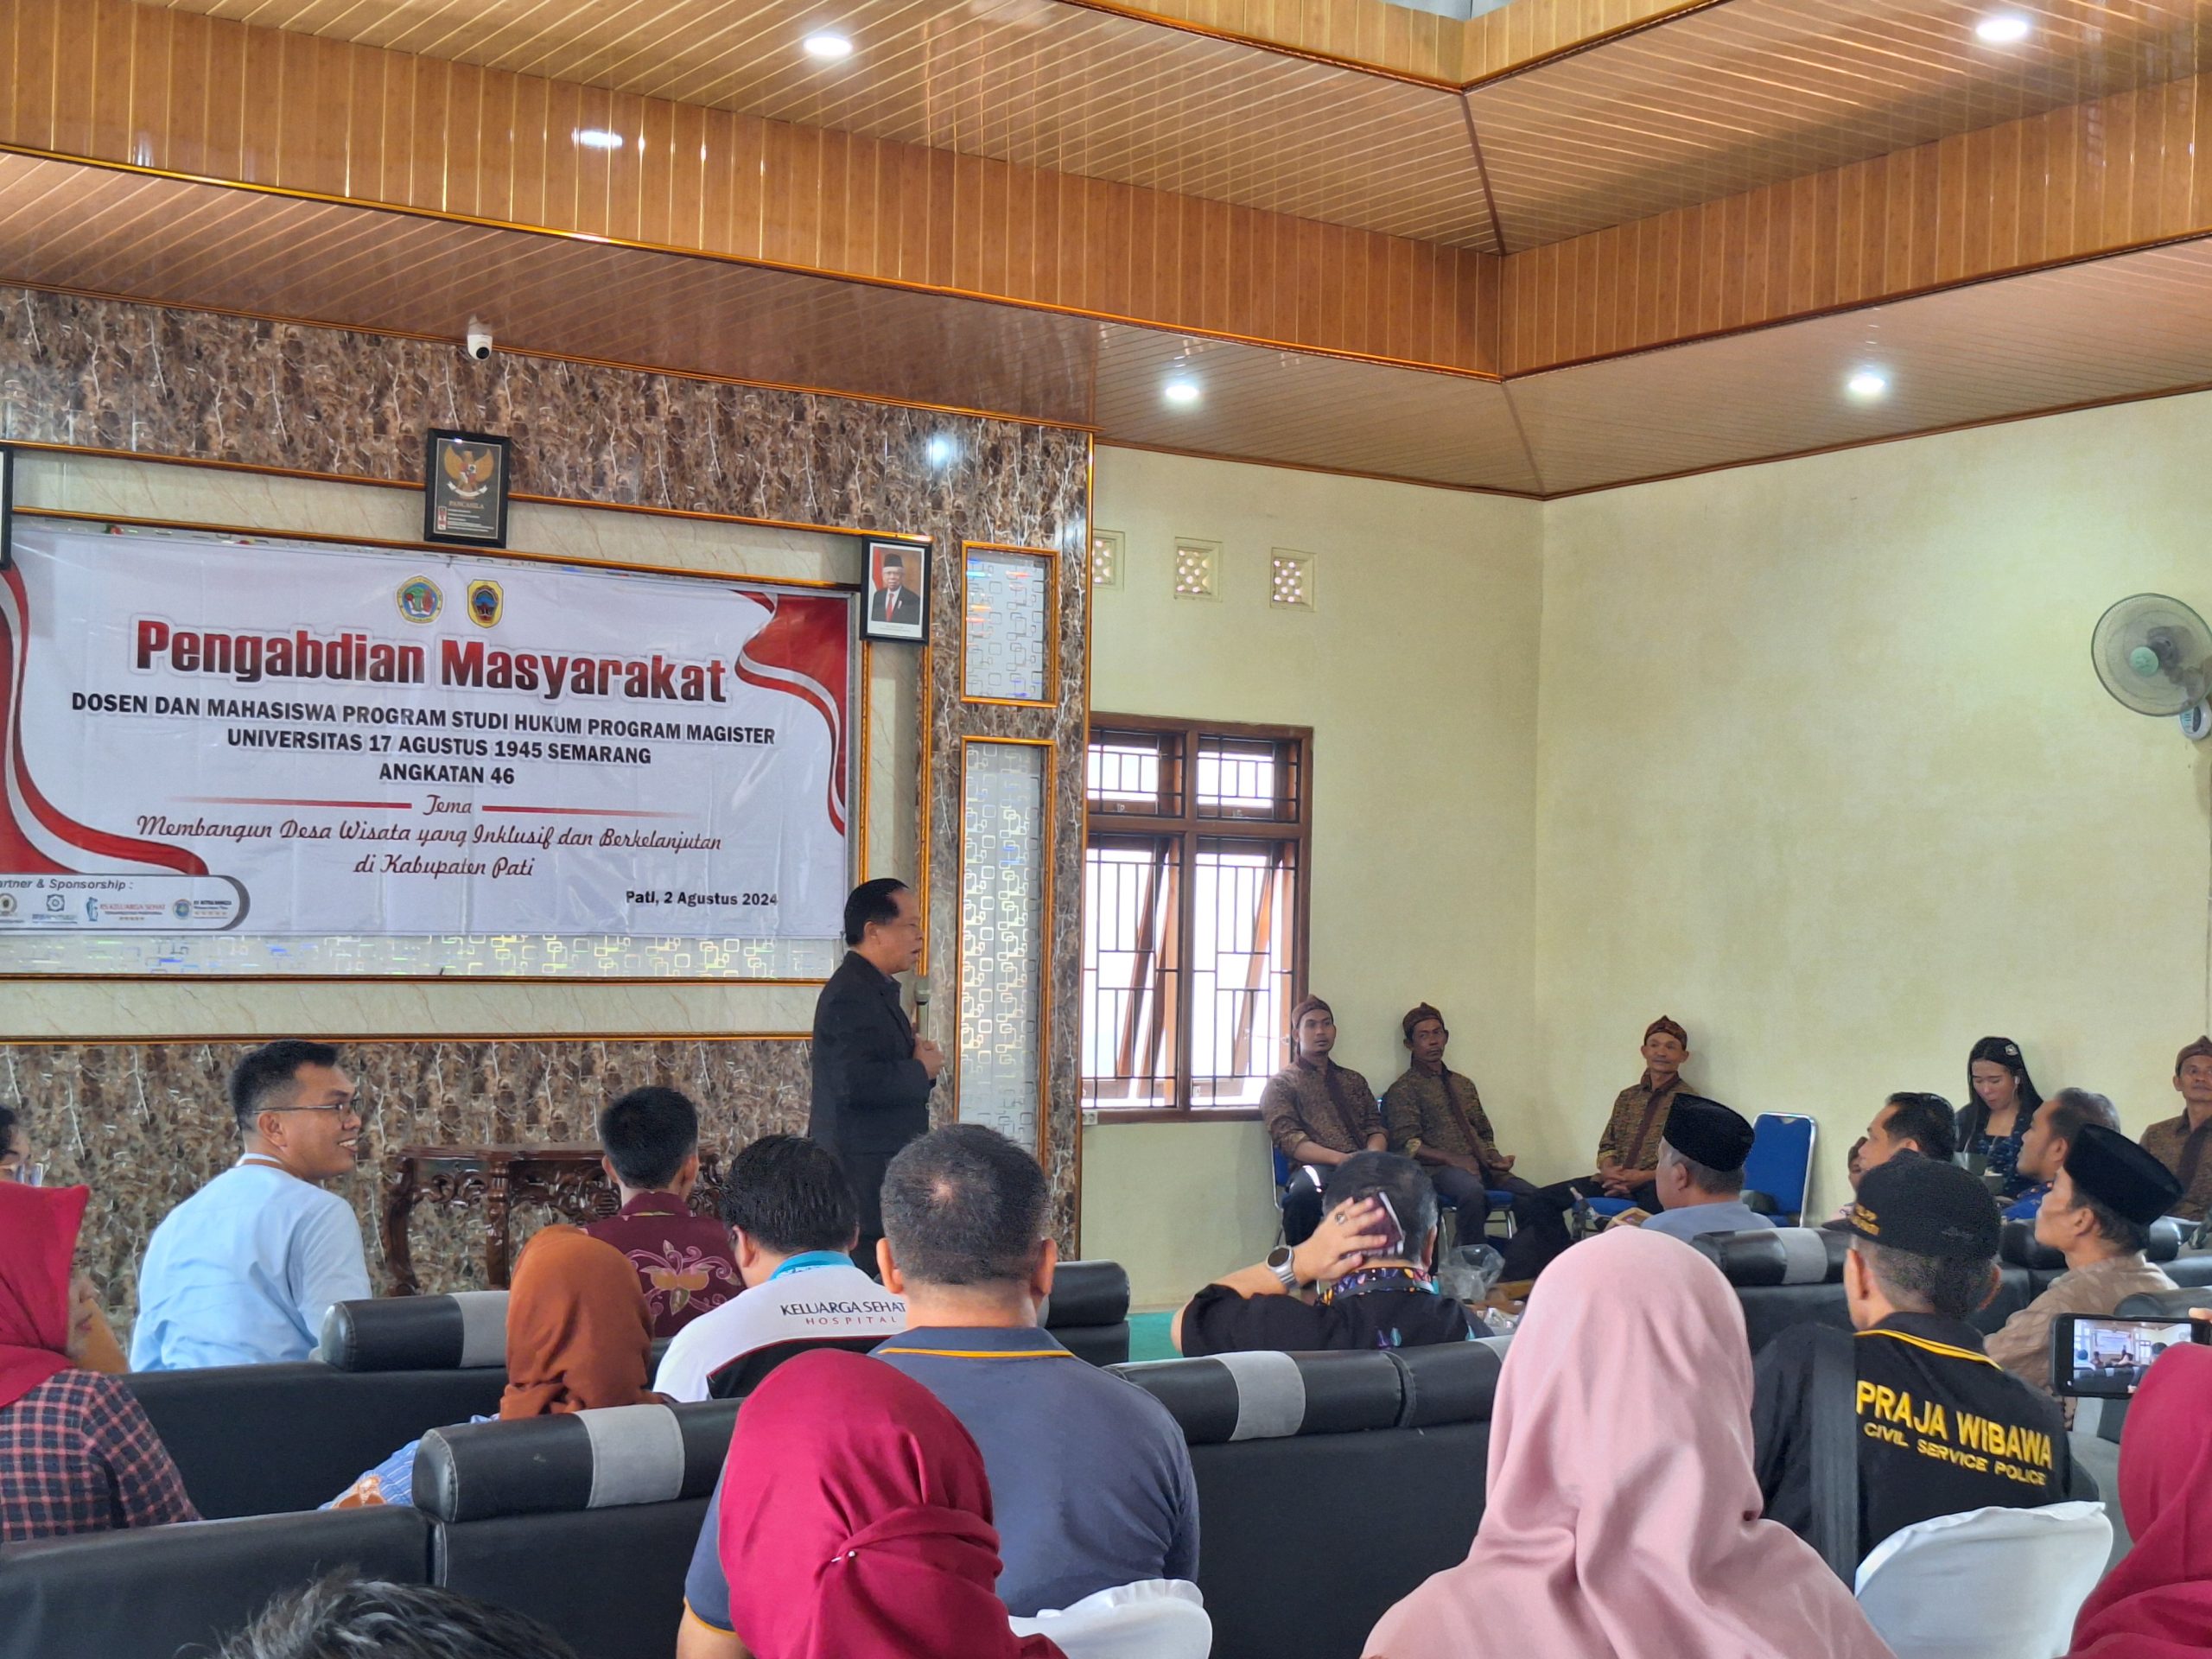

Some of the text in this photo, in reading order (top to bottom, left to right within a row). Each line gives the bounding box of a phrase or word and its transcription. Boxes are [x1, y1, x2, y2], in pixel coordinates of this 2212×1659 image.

[137, 620, 727, 703] Pengabdian Masyarakat
[72, 692, 776, 745] DOSEN DAN MAHASISWA PROGRAM STUDI HUKUM PROGRAM MAGISTER
[227, 728, 652, 765] UNIVERSITAS 17 AGUSTUS 1945 SEMARANG
[378, 763, 515, 785] ANGKATAN 46
[423, 794, 472, 816] Tema
[137, 815, 721, 854] Membangun Desa Wisata yang Inklusif dan Berkelanjutan
[353, 854, 536, 880] di Kabupaten Pati
[36, 879, 45, 889] &
[49, 880, 126, 891] Sponsorship
[626, 891, 779, 907] Pati, 2 Agustus 2024
[780, 1301, 906, 1316] KELUARGA SEHAT
[806, 1317, 897, 1325] HOSPITAL
[1856, 1380, 2052, 1469] PRAJA WIBAWA
[1864, 1422, 2047, 1486] CIVIL SERVICE POLICE
